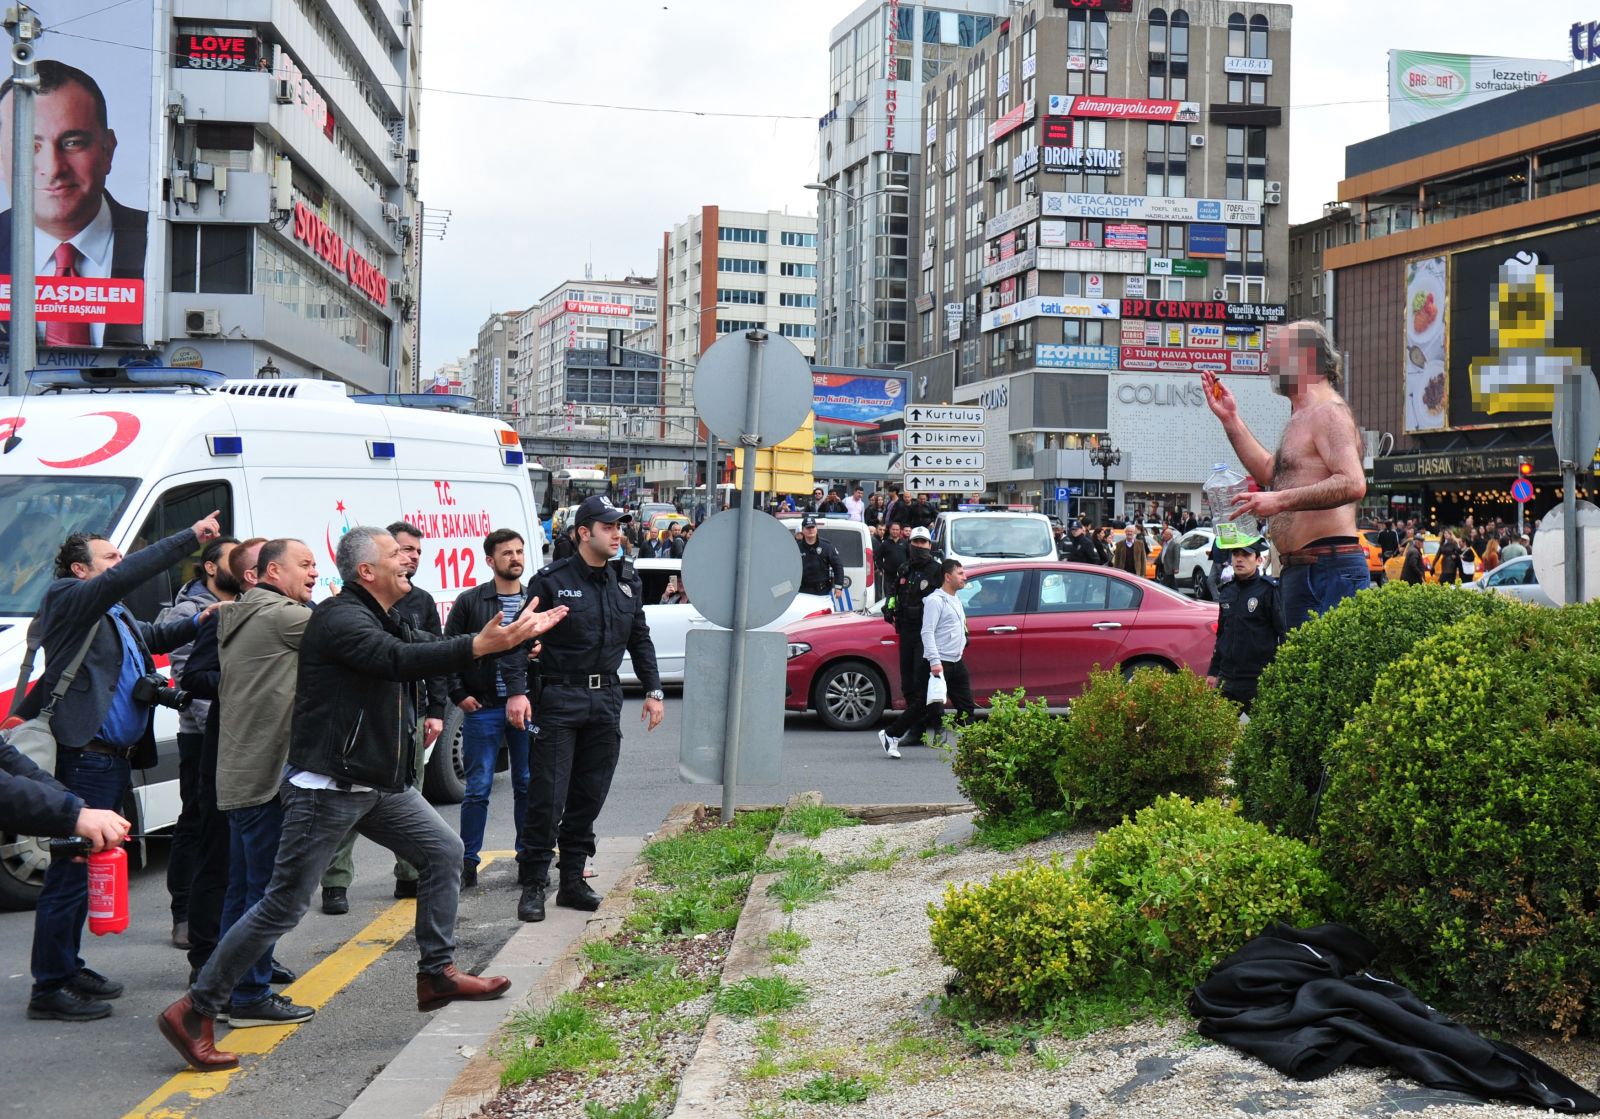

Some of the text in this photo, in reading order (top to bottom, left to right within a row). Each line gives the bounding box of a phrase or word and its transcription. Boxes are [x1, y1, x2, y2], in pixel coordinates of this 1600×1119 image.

[190, 36, 245, 52] LOVE
[1493, 69, 1548, 83] lezzetiniz
[1475, 80, 1521, 91] sofradaki
[1077, 100, 1173, 116] almanyayolu.com
[886, 90, 897, 152] HOTEL
[1045, 147, 1121, 168] DRONE STORE
[1068, 195, 1144, 207] NETACADEMY
[1081, 206, 1129, 217] ENGLISH
[1226, 204, 1245, 212] TOEFL
[295, 201, 345, 273] SOYSAL
[35, 285, 136, 303] TAŞDELEN
[35, 303, 106, 315] ELEDİYE BAŞKANI
[600, 304, 628, 315] EĞİTİM
[1156, 301, 1227, 319] CENTER
[1228, 303, 1284, 316] Güzellik & Estetik
[1191, 336, 1219, 345] tour
[1136, 348, 1159, 358] TÜRK
[1162, 350, 1187, 359] HAVA
[1189, 352, 1227, 360] YOLLARI
[828, 395, 853, 404] Kalite
[856, 397, 893, 405] Tasarruf
[980, 384, 1008, 410] COLIN'S
[1117, 381, 1203, 406] COLIN'S
[926, 409, 981, 421] Kurtuluş
[926, 432, 980, 442] Dikimevi
[926, 456, 977, 465] Cebeci
[1418, 457, 1453, 475] HASAN
[926, 478, 980, 487] Mamak
[434, 480, 456, 506] T.C.
[1058, 489, 1066, 497] P
[404, 509, 490, 539] SAĞLIK BAKANLIĞI
[435, 548, 477, 589] 112
